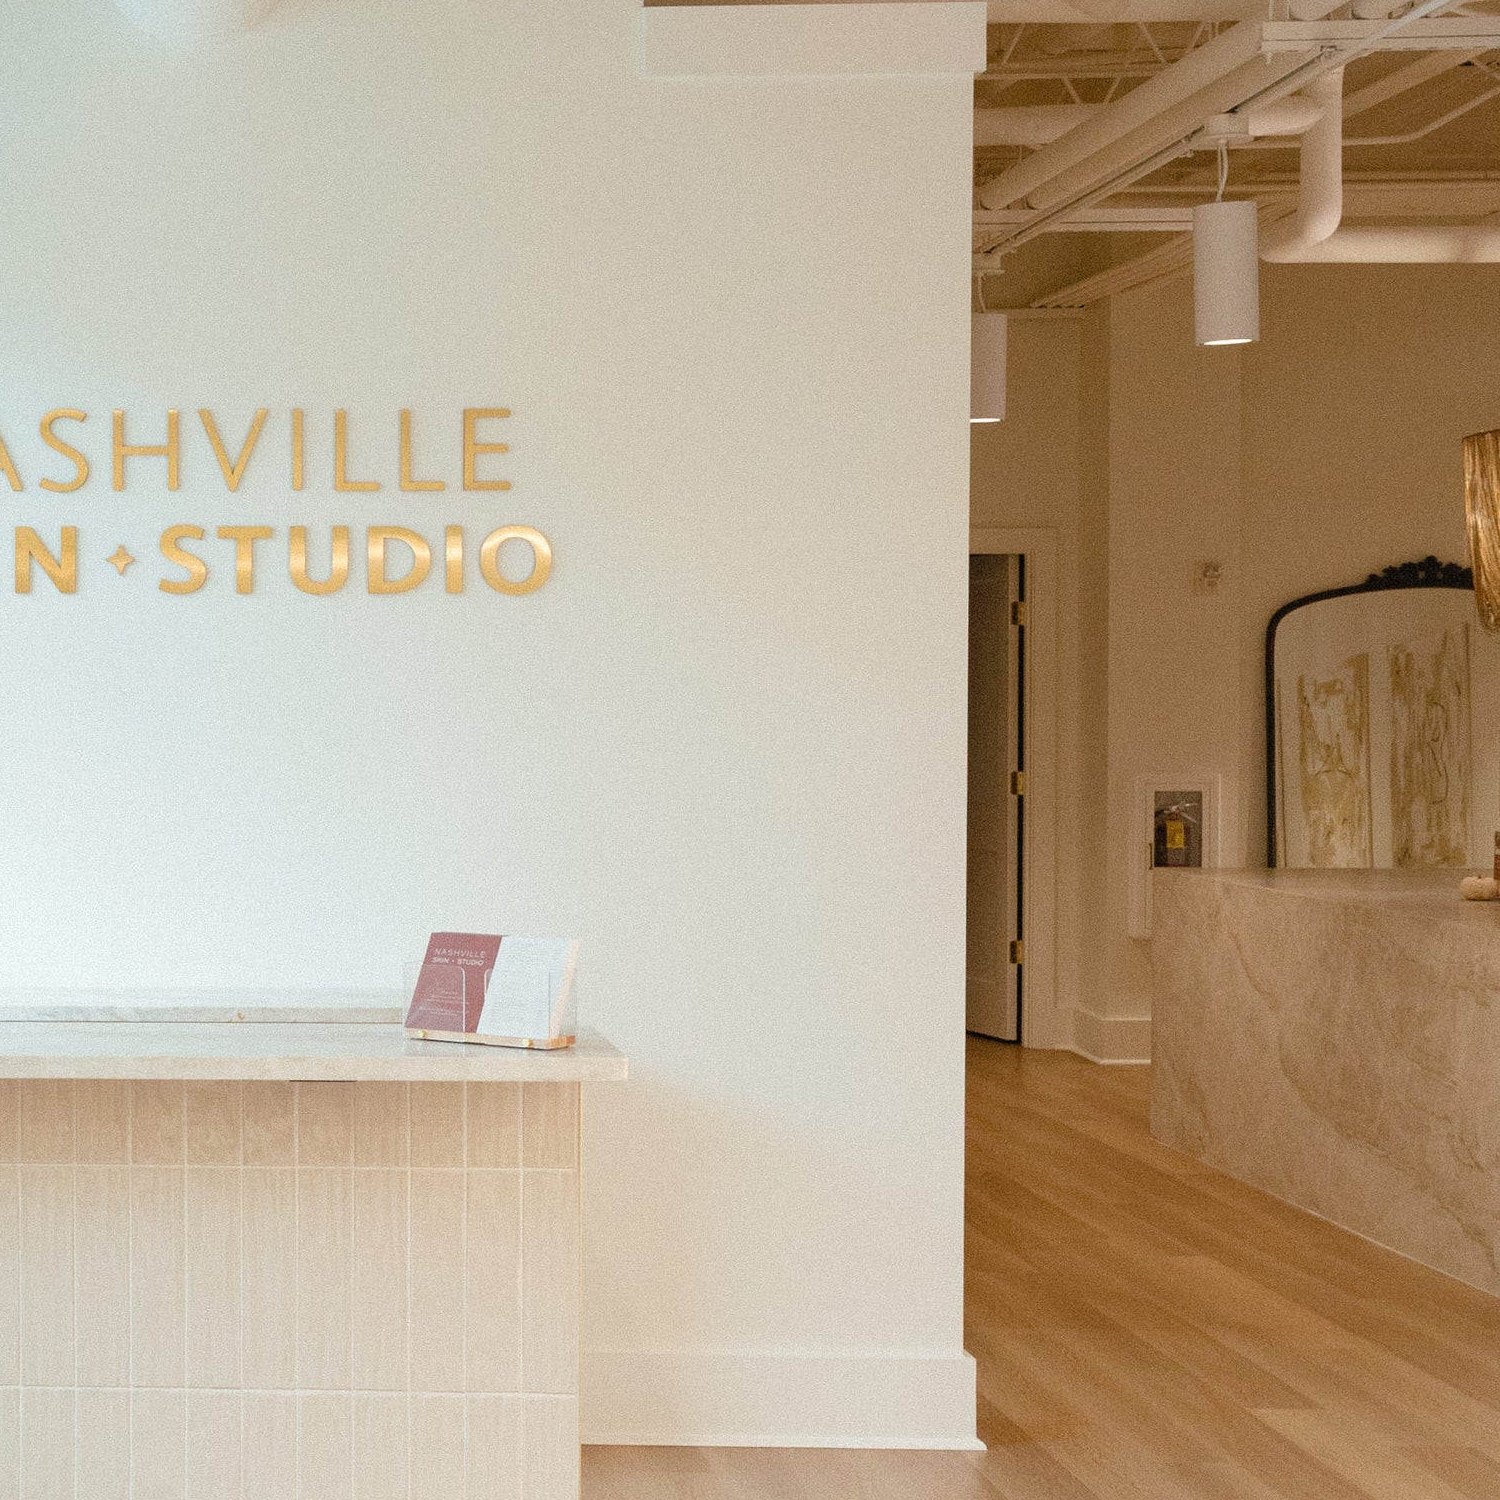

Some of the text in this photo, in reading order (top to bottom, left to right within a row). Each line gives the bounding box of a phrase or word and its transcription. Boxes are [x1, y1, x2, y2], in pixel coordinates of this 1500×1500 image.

[157, 523, 554, 597] STUDIO
[434, 947, 487, 958] NASHVILLE
[431, 956, 485, 966] SKIN STUDIO
